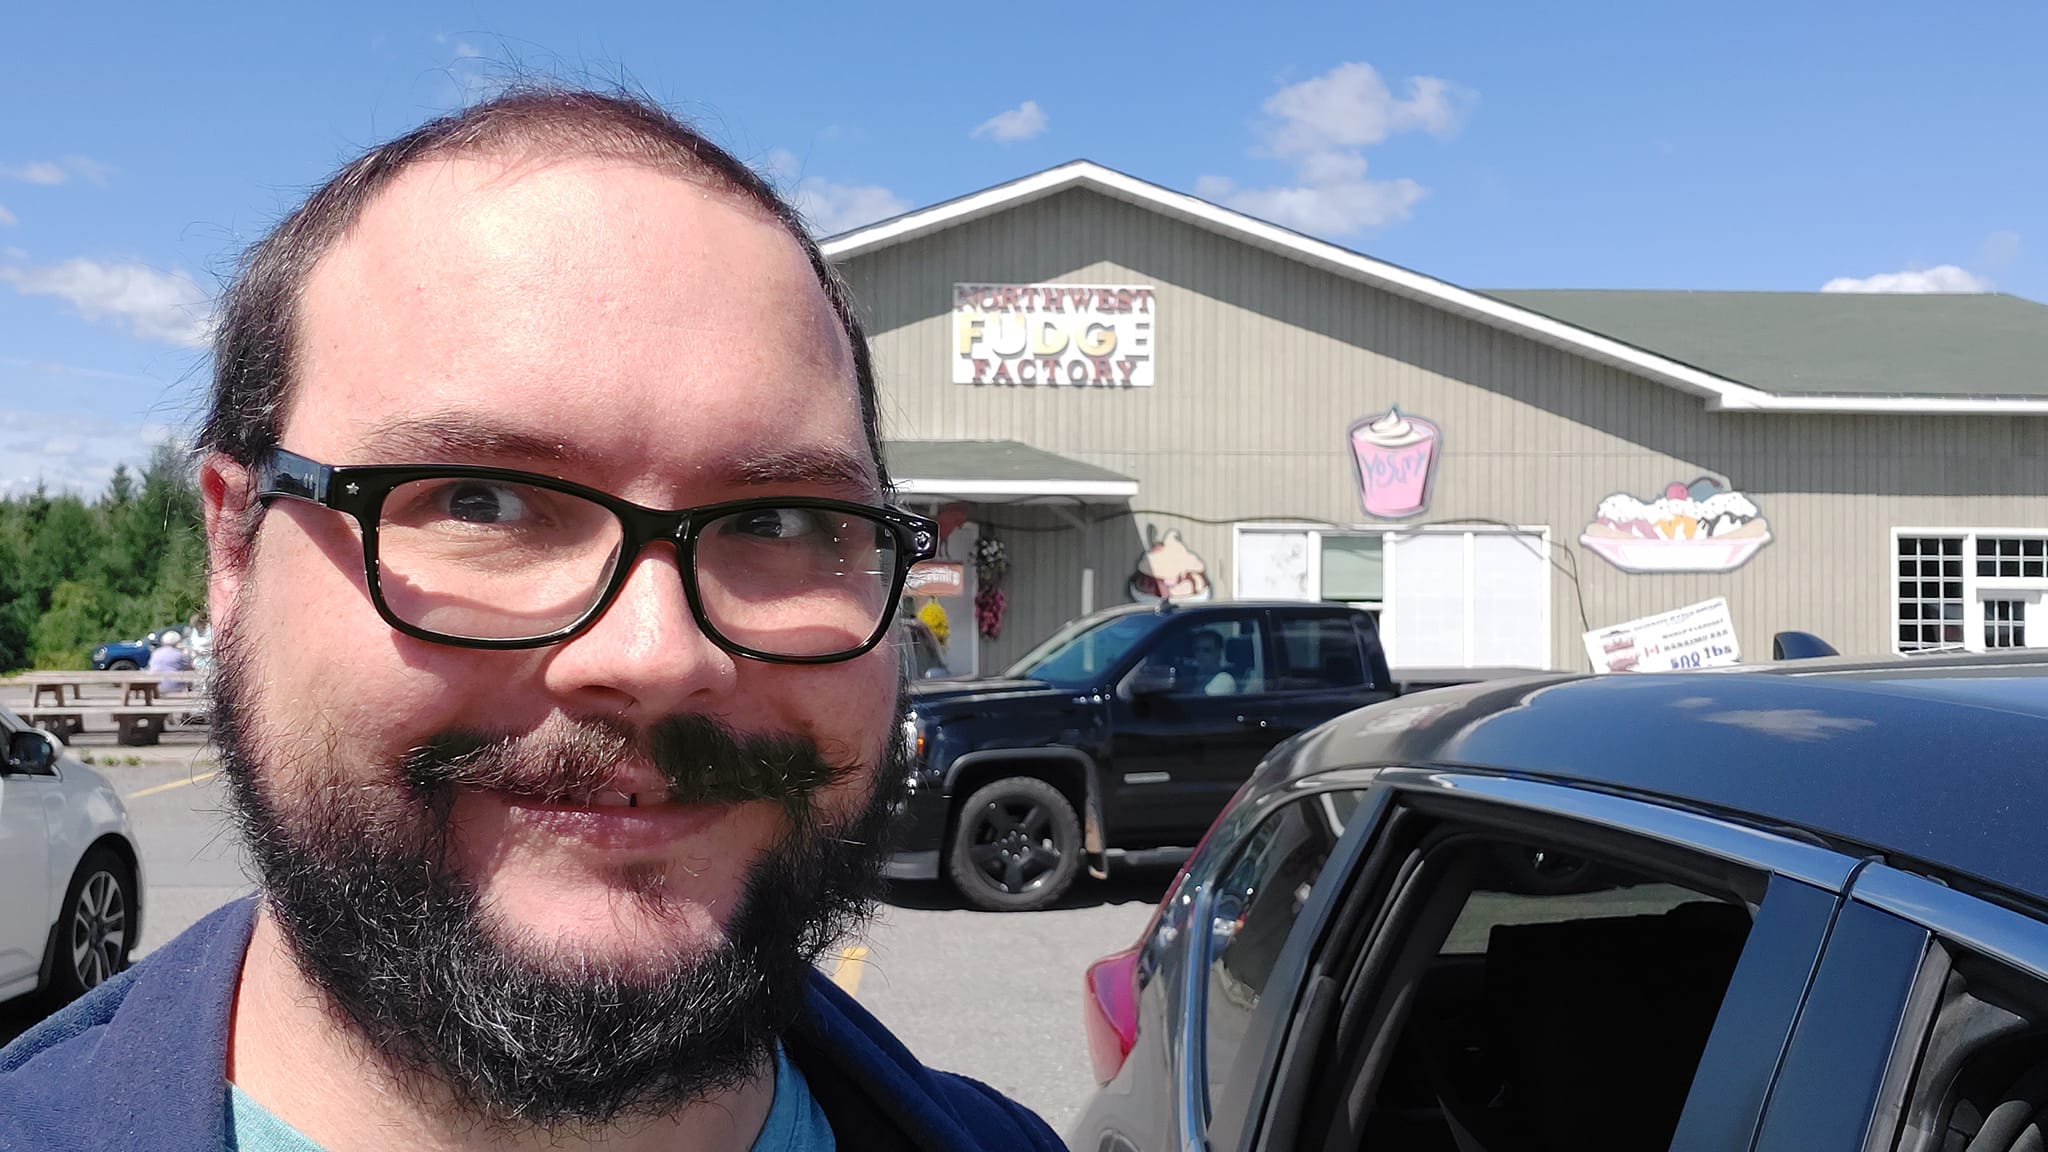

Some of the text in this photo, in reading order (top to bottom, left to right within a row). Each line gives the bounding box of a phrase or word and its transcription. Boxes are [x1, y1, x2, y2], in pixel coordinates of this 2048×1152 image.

[953, 285, 1153, 313] NORTHWEST
[959, 313, 1150, 359] FUDGE
[972, 358, 1137, 388] FACTORY
